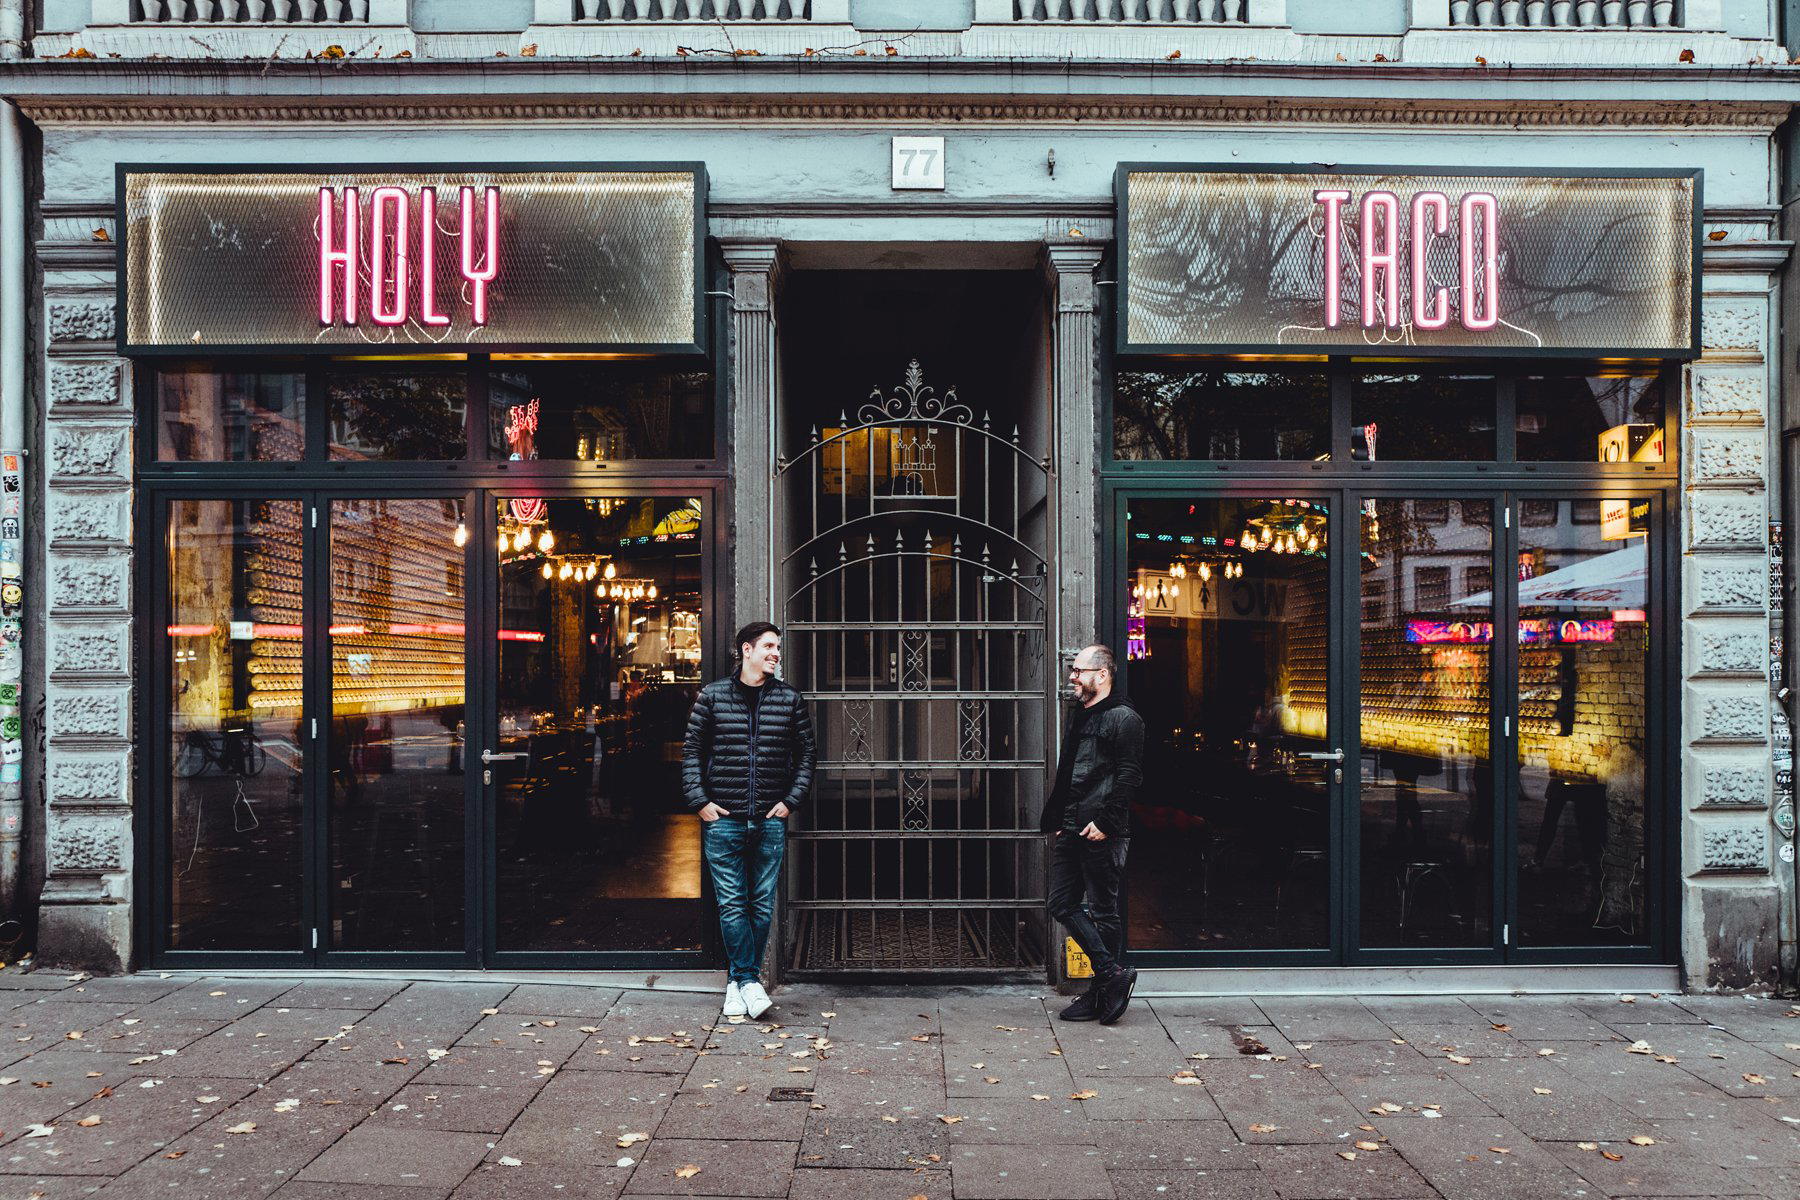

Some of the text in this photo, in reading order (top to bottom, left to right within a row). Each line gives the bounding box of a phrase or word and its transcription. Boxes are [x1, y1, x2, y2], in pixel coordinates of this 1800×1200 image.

[899, 149, 937, 176] 77
[319, 186, 501, 328] HOLY
[1313, 189, 1499, 332] TACO
